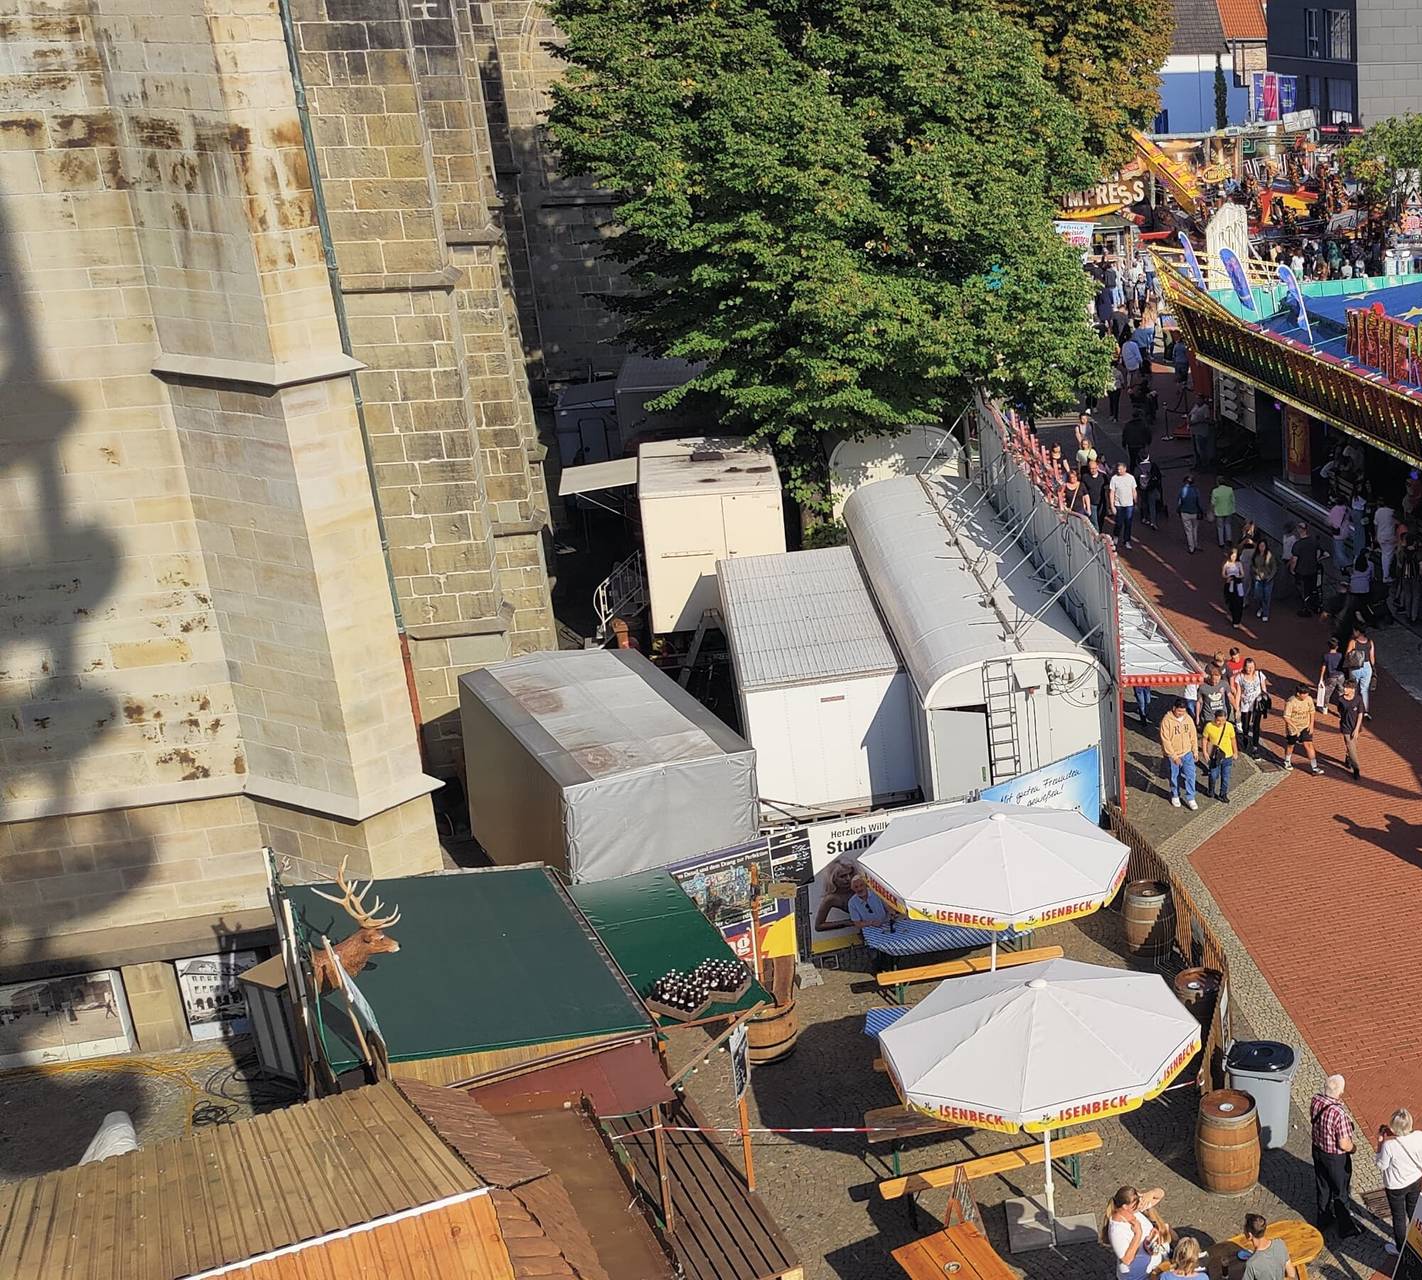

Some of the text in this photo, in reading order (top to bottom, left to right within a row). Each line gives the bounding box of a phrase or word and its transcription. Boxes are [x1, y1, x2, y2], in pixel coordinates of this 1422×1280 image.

[831, 826, 866, 839] Herzlich
[936, 909, 995, 927] ISENBECK
[1041, 901, 1093, 922] ISENBECK
[1163, 1039, 1196, 1080] ISENBECK
[939, 1104, 1004, 1126] ISENBECK
[1060, 1094, 1128, 1121] ISENBECK
